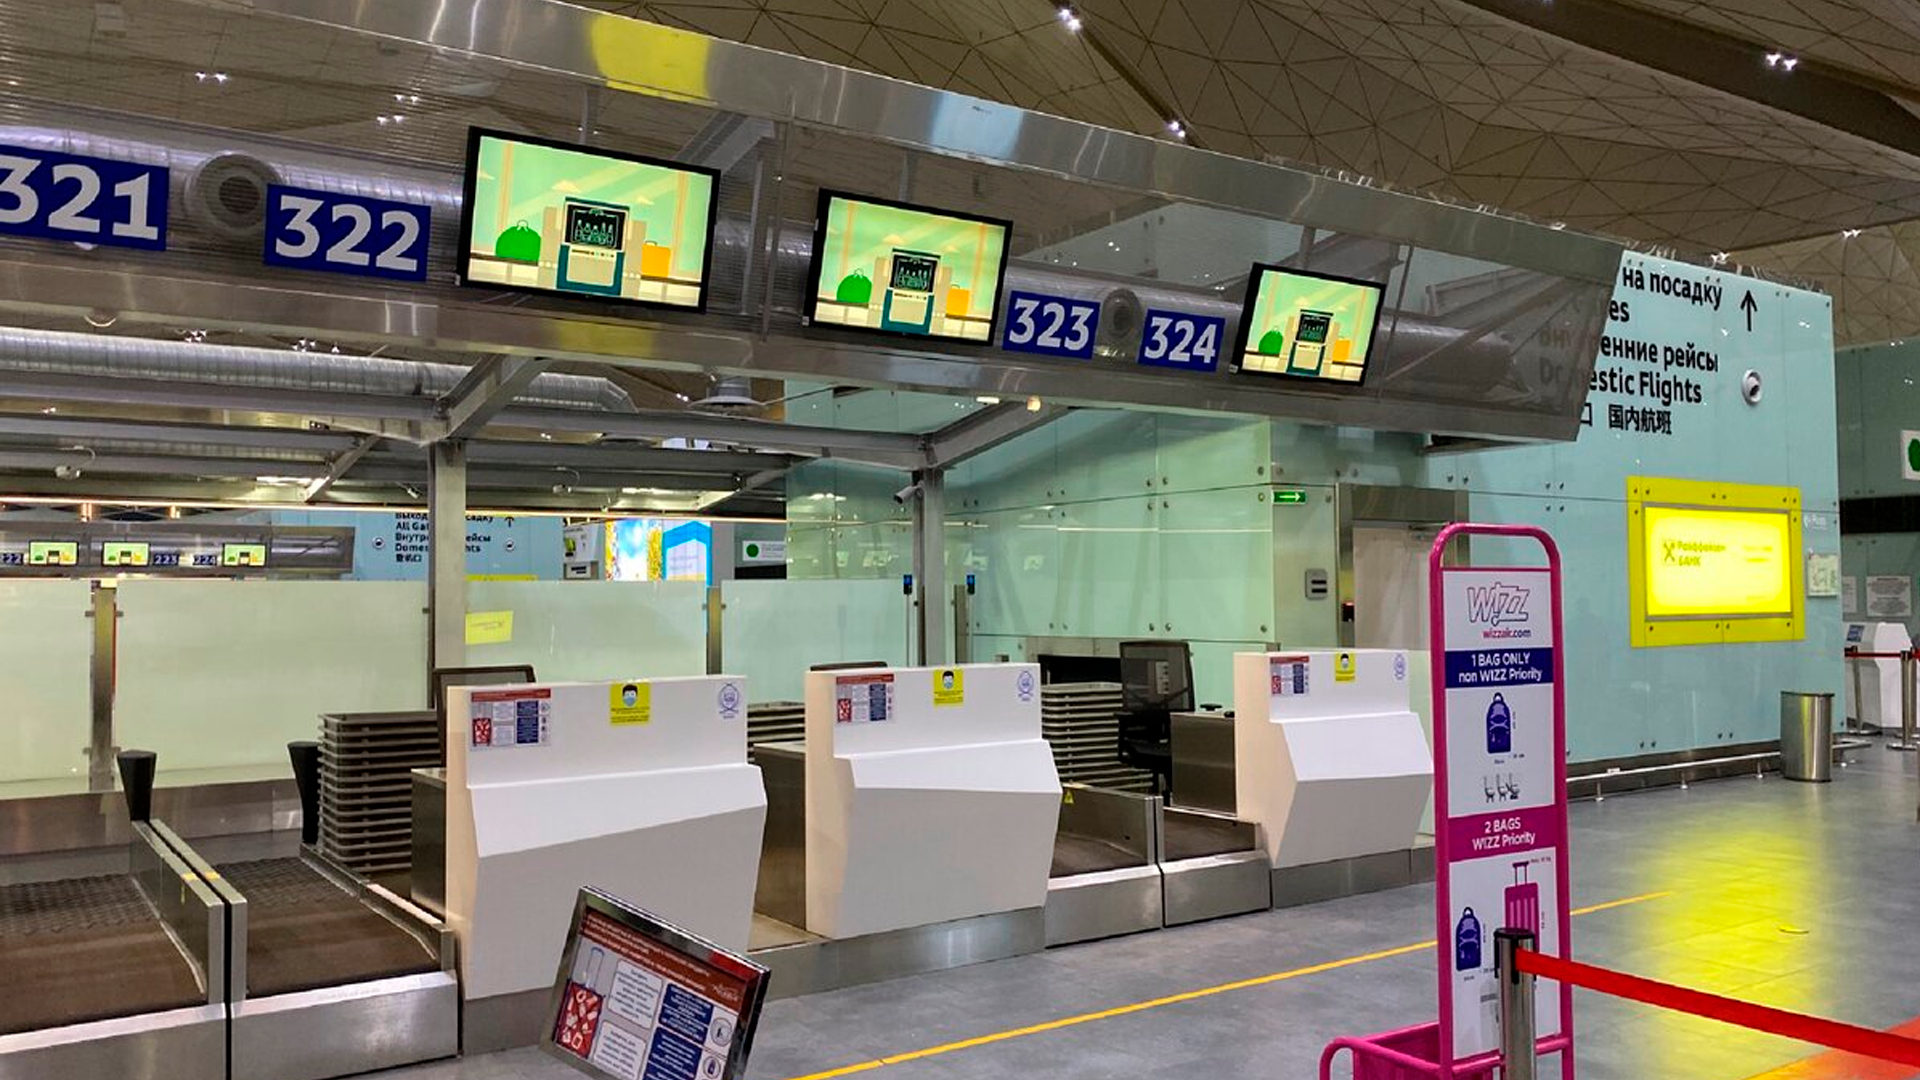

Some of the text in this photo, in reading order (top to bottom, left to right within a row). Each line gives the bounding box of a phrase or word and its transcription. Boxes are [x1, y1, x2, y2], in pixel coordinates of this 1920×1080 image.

[0, 155, 158, 241] 321
[275, 194, 422, 272] 322
[1622, 266, 1722, 311] на посадку
[1008, 298, 1094, 351] 323
[1144, 316, 1218, 363] 324
[1664, 342, 1719, 372] рейсы
[1640, 371, 1702, 406] Flights
[1608, 403, 1672, 435] 国内航班
[1482, 627, 1531, 639] wizzair.com
[1459, 667, 1542, 683] non WIZZ Priority
[1471, 652, 1530, 667] 1 BAG ONLY
[1472, 832, 1535, 850] WIZZ Priority
[1484, 817, 1521, 834] 2 BAGS
